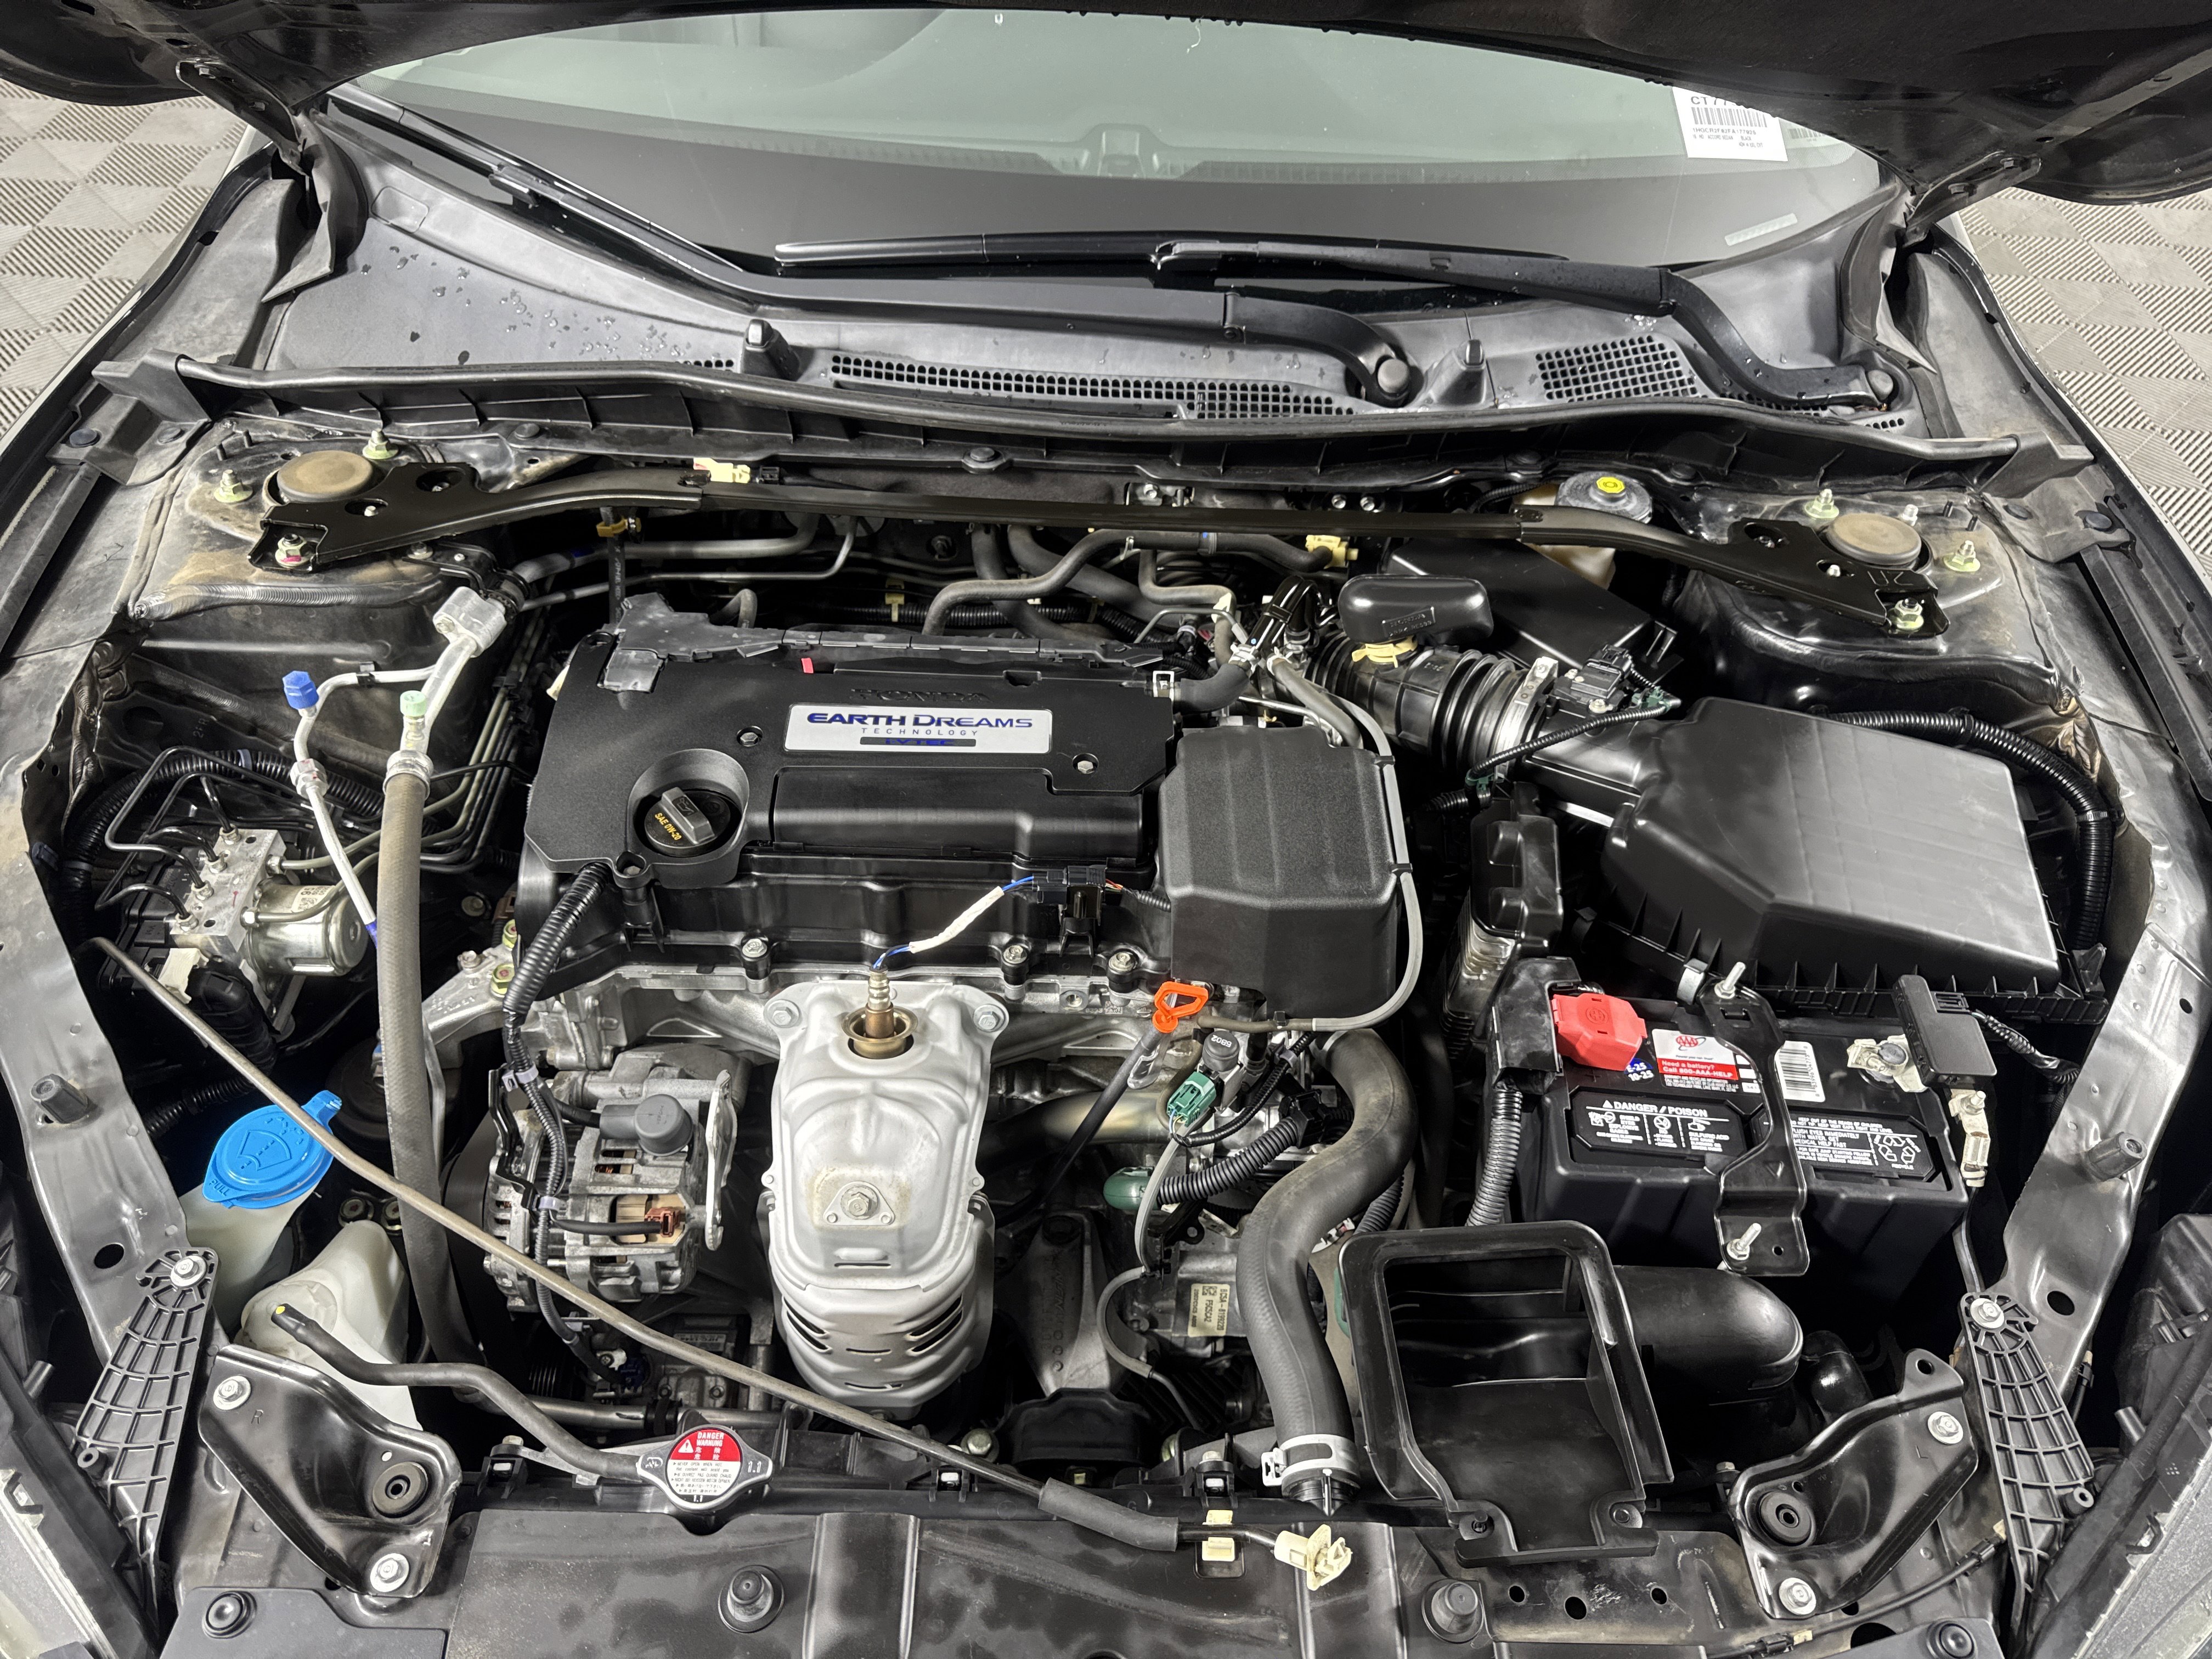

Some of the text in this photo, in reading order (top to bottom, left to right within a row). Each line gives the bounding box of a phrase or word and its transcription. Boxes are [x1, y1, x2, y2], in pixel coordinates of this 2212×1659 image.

[849, 689, 994, 703] HONDA
[807, 713, 1033, 728] EARTH DREAMS
[862, 727, 979, 736] TECHNOLOGY
[654, 812, 669, 825] SAE
[664, 823, 682, 840] 0W-20
[1677, 1036, 1699, 1047] AAA
[1687, 1062, 1715, 1070] battery?
[1628, 1071, 1654, 1081] 10-25
[1679, 1068, 1733, 1077] 800-AAA-HELP
[1613, 1101, 1658, 1113] DANGER
[1668, 1106, 1708, 1118] POISON
[1824, 1131, 1859, 1139] IMMEDIATELY
[208, 1179, 231, 1197] PULL
[251, 1409, 264, 1425] R
[748, 1461, 761, 1474] 1.1
[693, 1494, 703, 1503] 1.1
